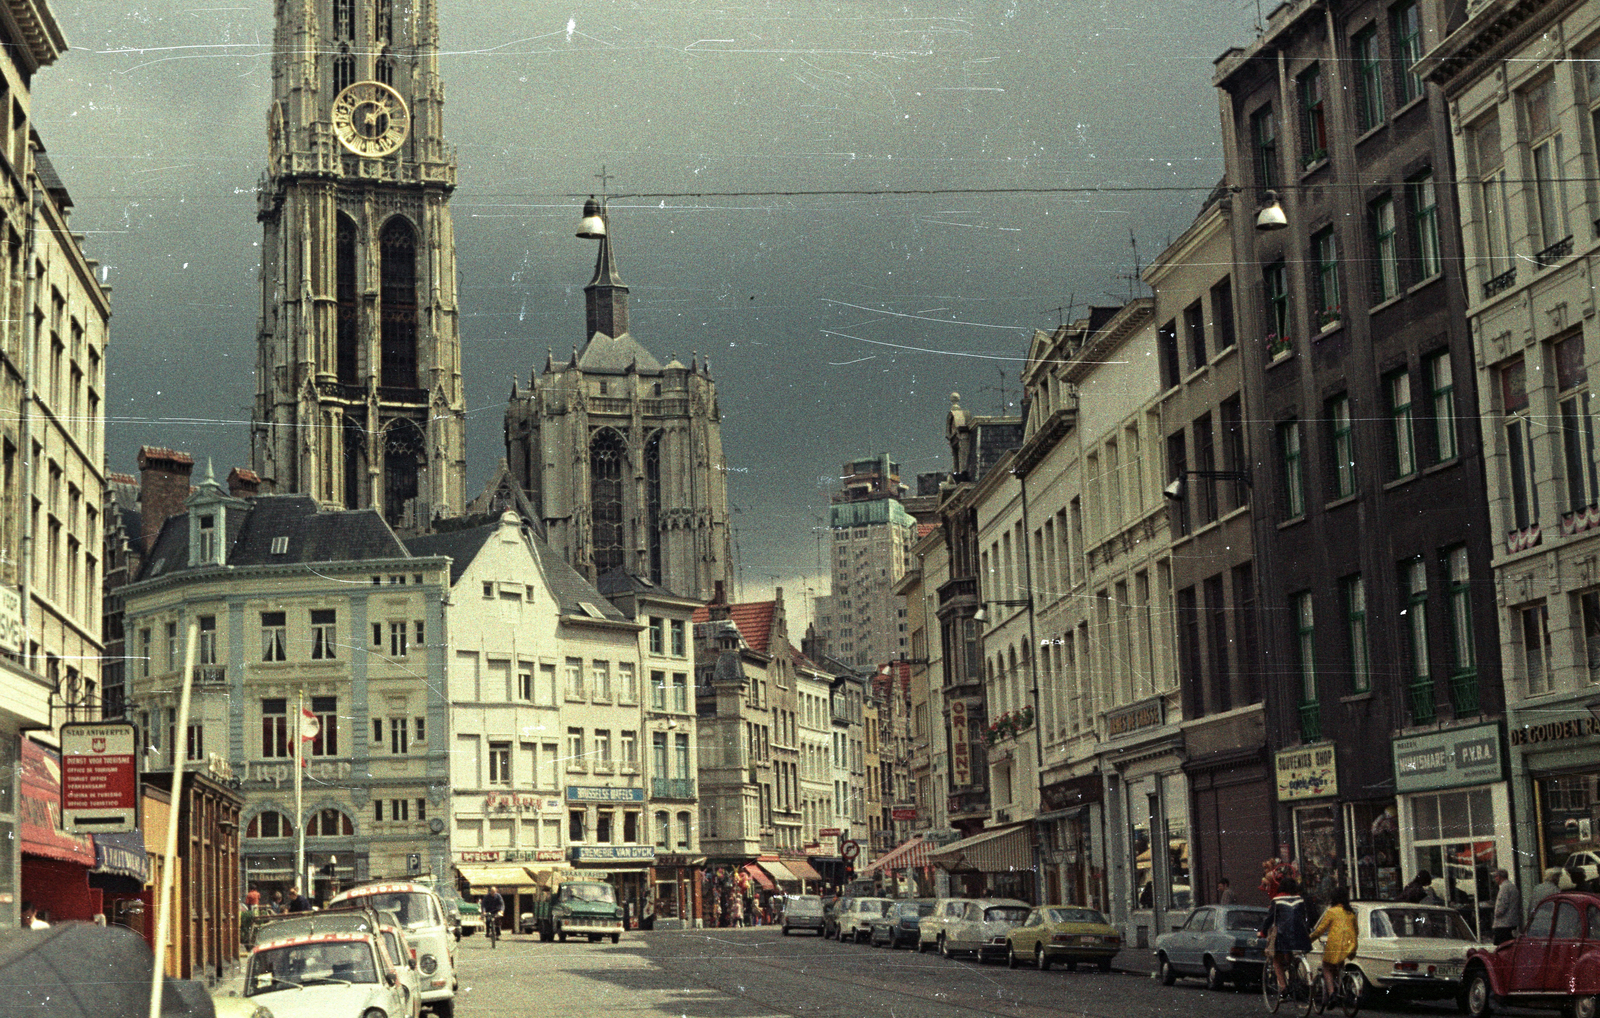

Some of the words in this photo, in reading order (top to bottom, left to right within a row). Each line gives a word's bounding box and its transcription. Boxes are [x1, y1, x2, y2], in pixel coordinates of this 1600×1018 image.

[87, 728, 130, 736] ANTWERPEN
[952, 701, 969, 782] ORIENT
[1511, 727, 1527, 746] DE
[1528, 718, 1582, 744] GOUDEN
[239, 759, 351, 789] Jupler
[579, 847, 614, 858] CREMERIE
[615, 847, 631, 858] VAN
[632, 847, 653, 858] DYCK
[408, 857, 419, 870] P
